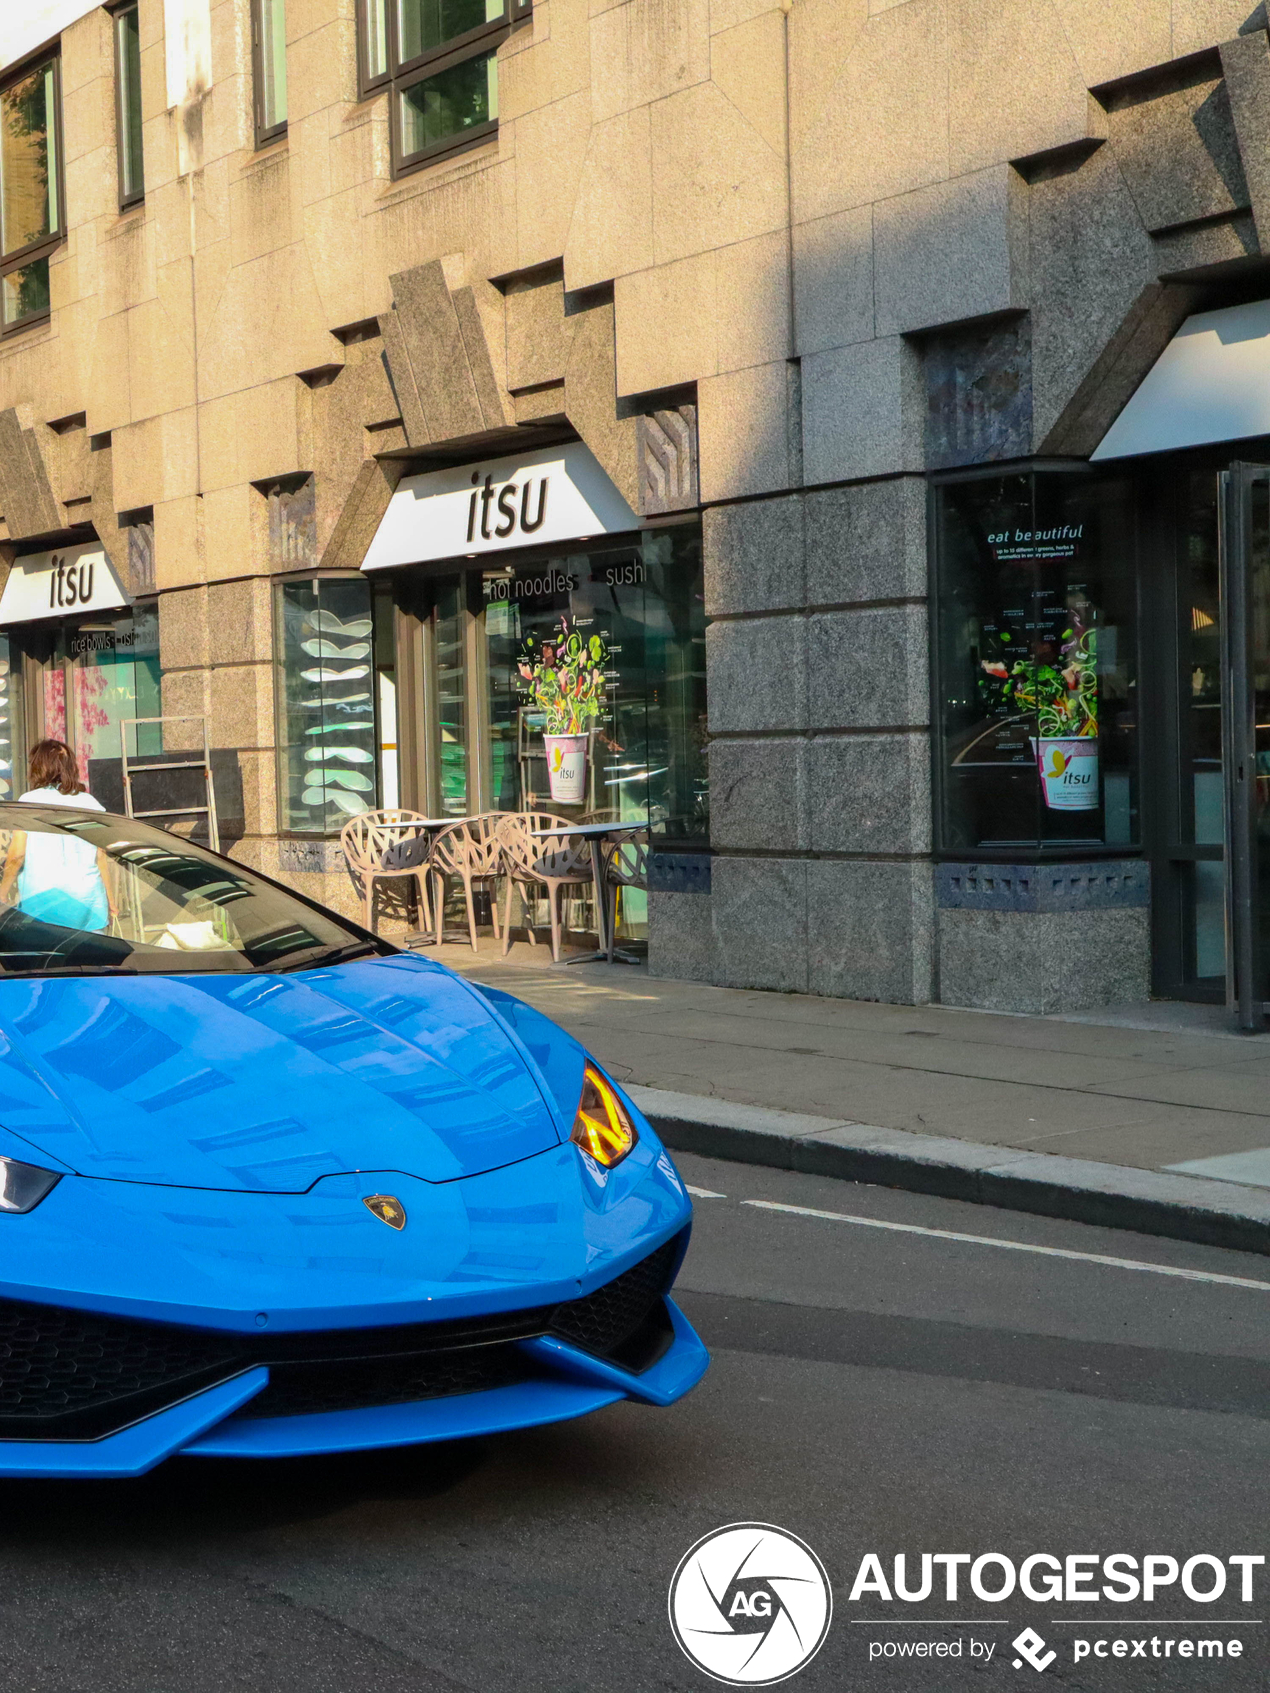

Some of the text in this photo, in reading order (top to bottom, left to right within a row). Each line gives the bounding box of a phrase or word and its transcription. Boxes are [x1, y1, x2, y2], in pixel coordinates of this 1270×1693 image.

[466, 471, 550, 543] itsu
[987, 524, 1083, 543] eat beautiful
[50, 554, 95, 609] itsu
[489, 558, 647, 600] hot noodles sushi
[71, 636, 86, 653] rice
[87, 632, 111, 652] bowls
[559, 766, 575, 779] itsu
[1063, 771, 1091, 784] itsu
